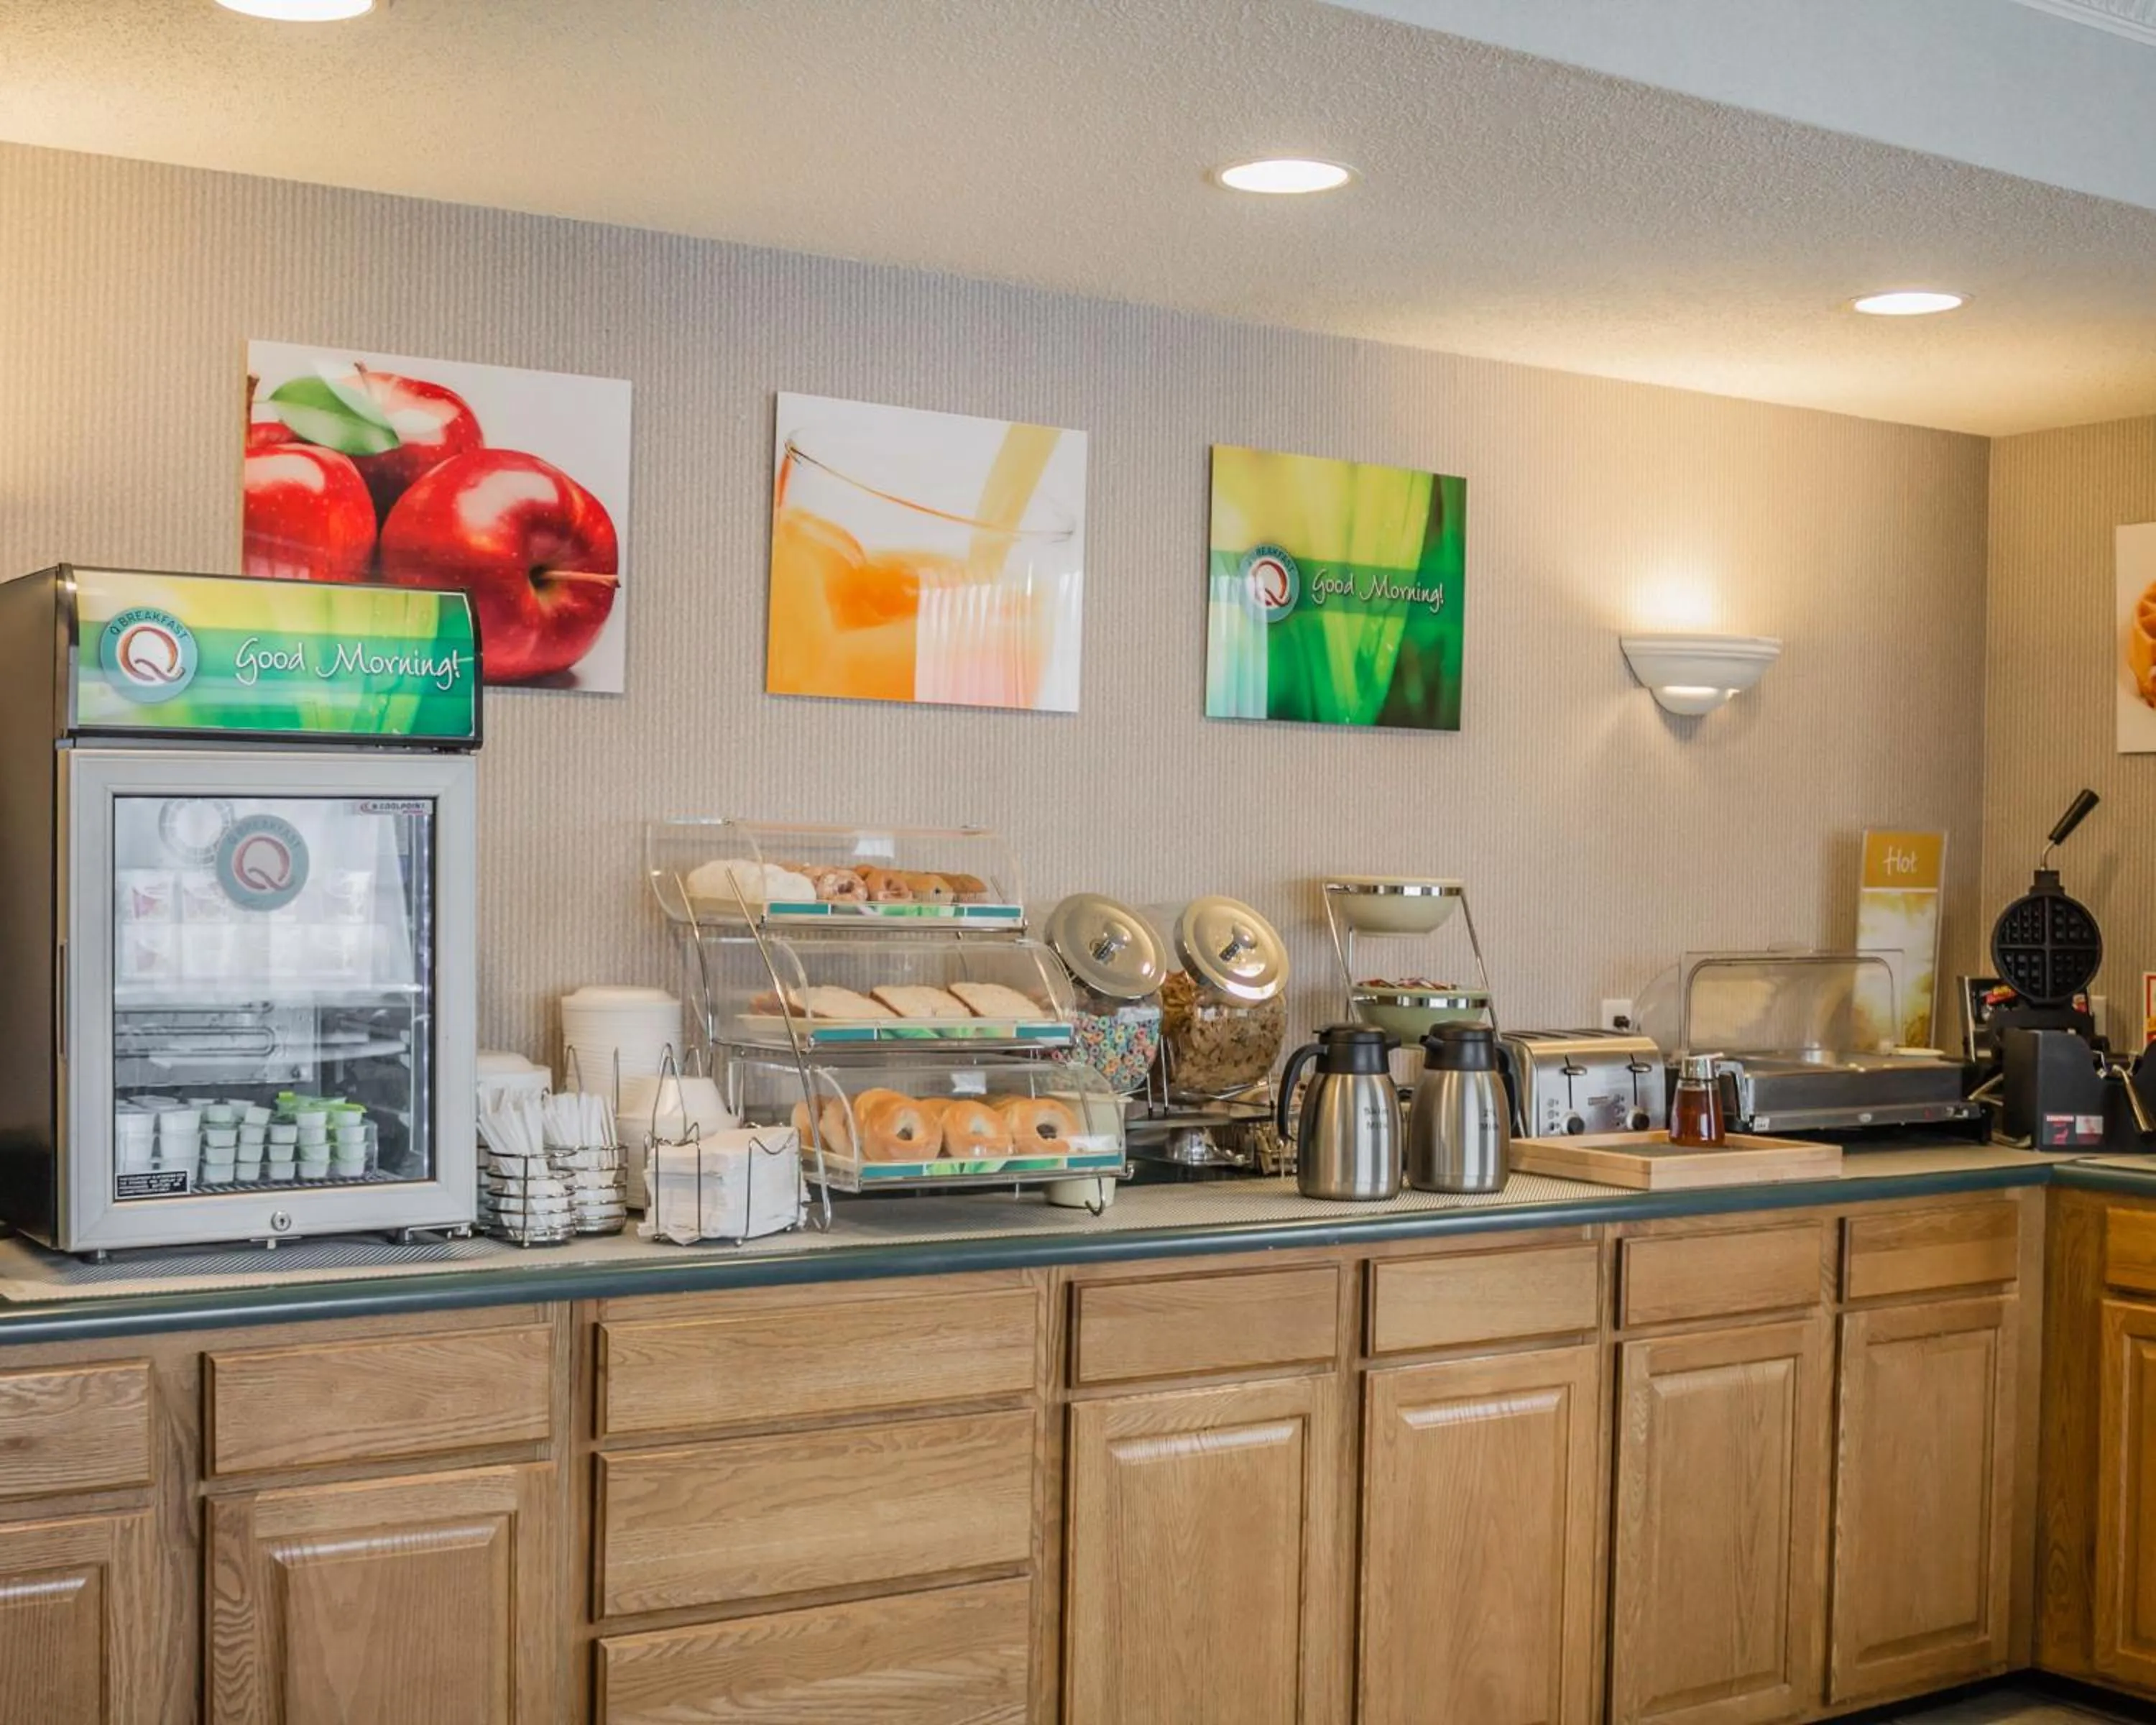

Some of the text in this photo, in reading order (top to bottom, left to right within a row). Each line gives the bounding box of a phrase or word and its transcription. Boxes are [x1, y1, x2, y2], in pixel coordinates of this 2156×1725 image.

[1312, 569, 1444, 614] Good Morning!
[118, 610, 188, 638] BREAKFAST
[119, 626, 185, 682] Q
[235, 638, 461, 691] Good Morning!
[233, 836, 296, 891] Q
[1883, 845, 1917, 875] Hot
